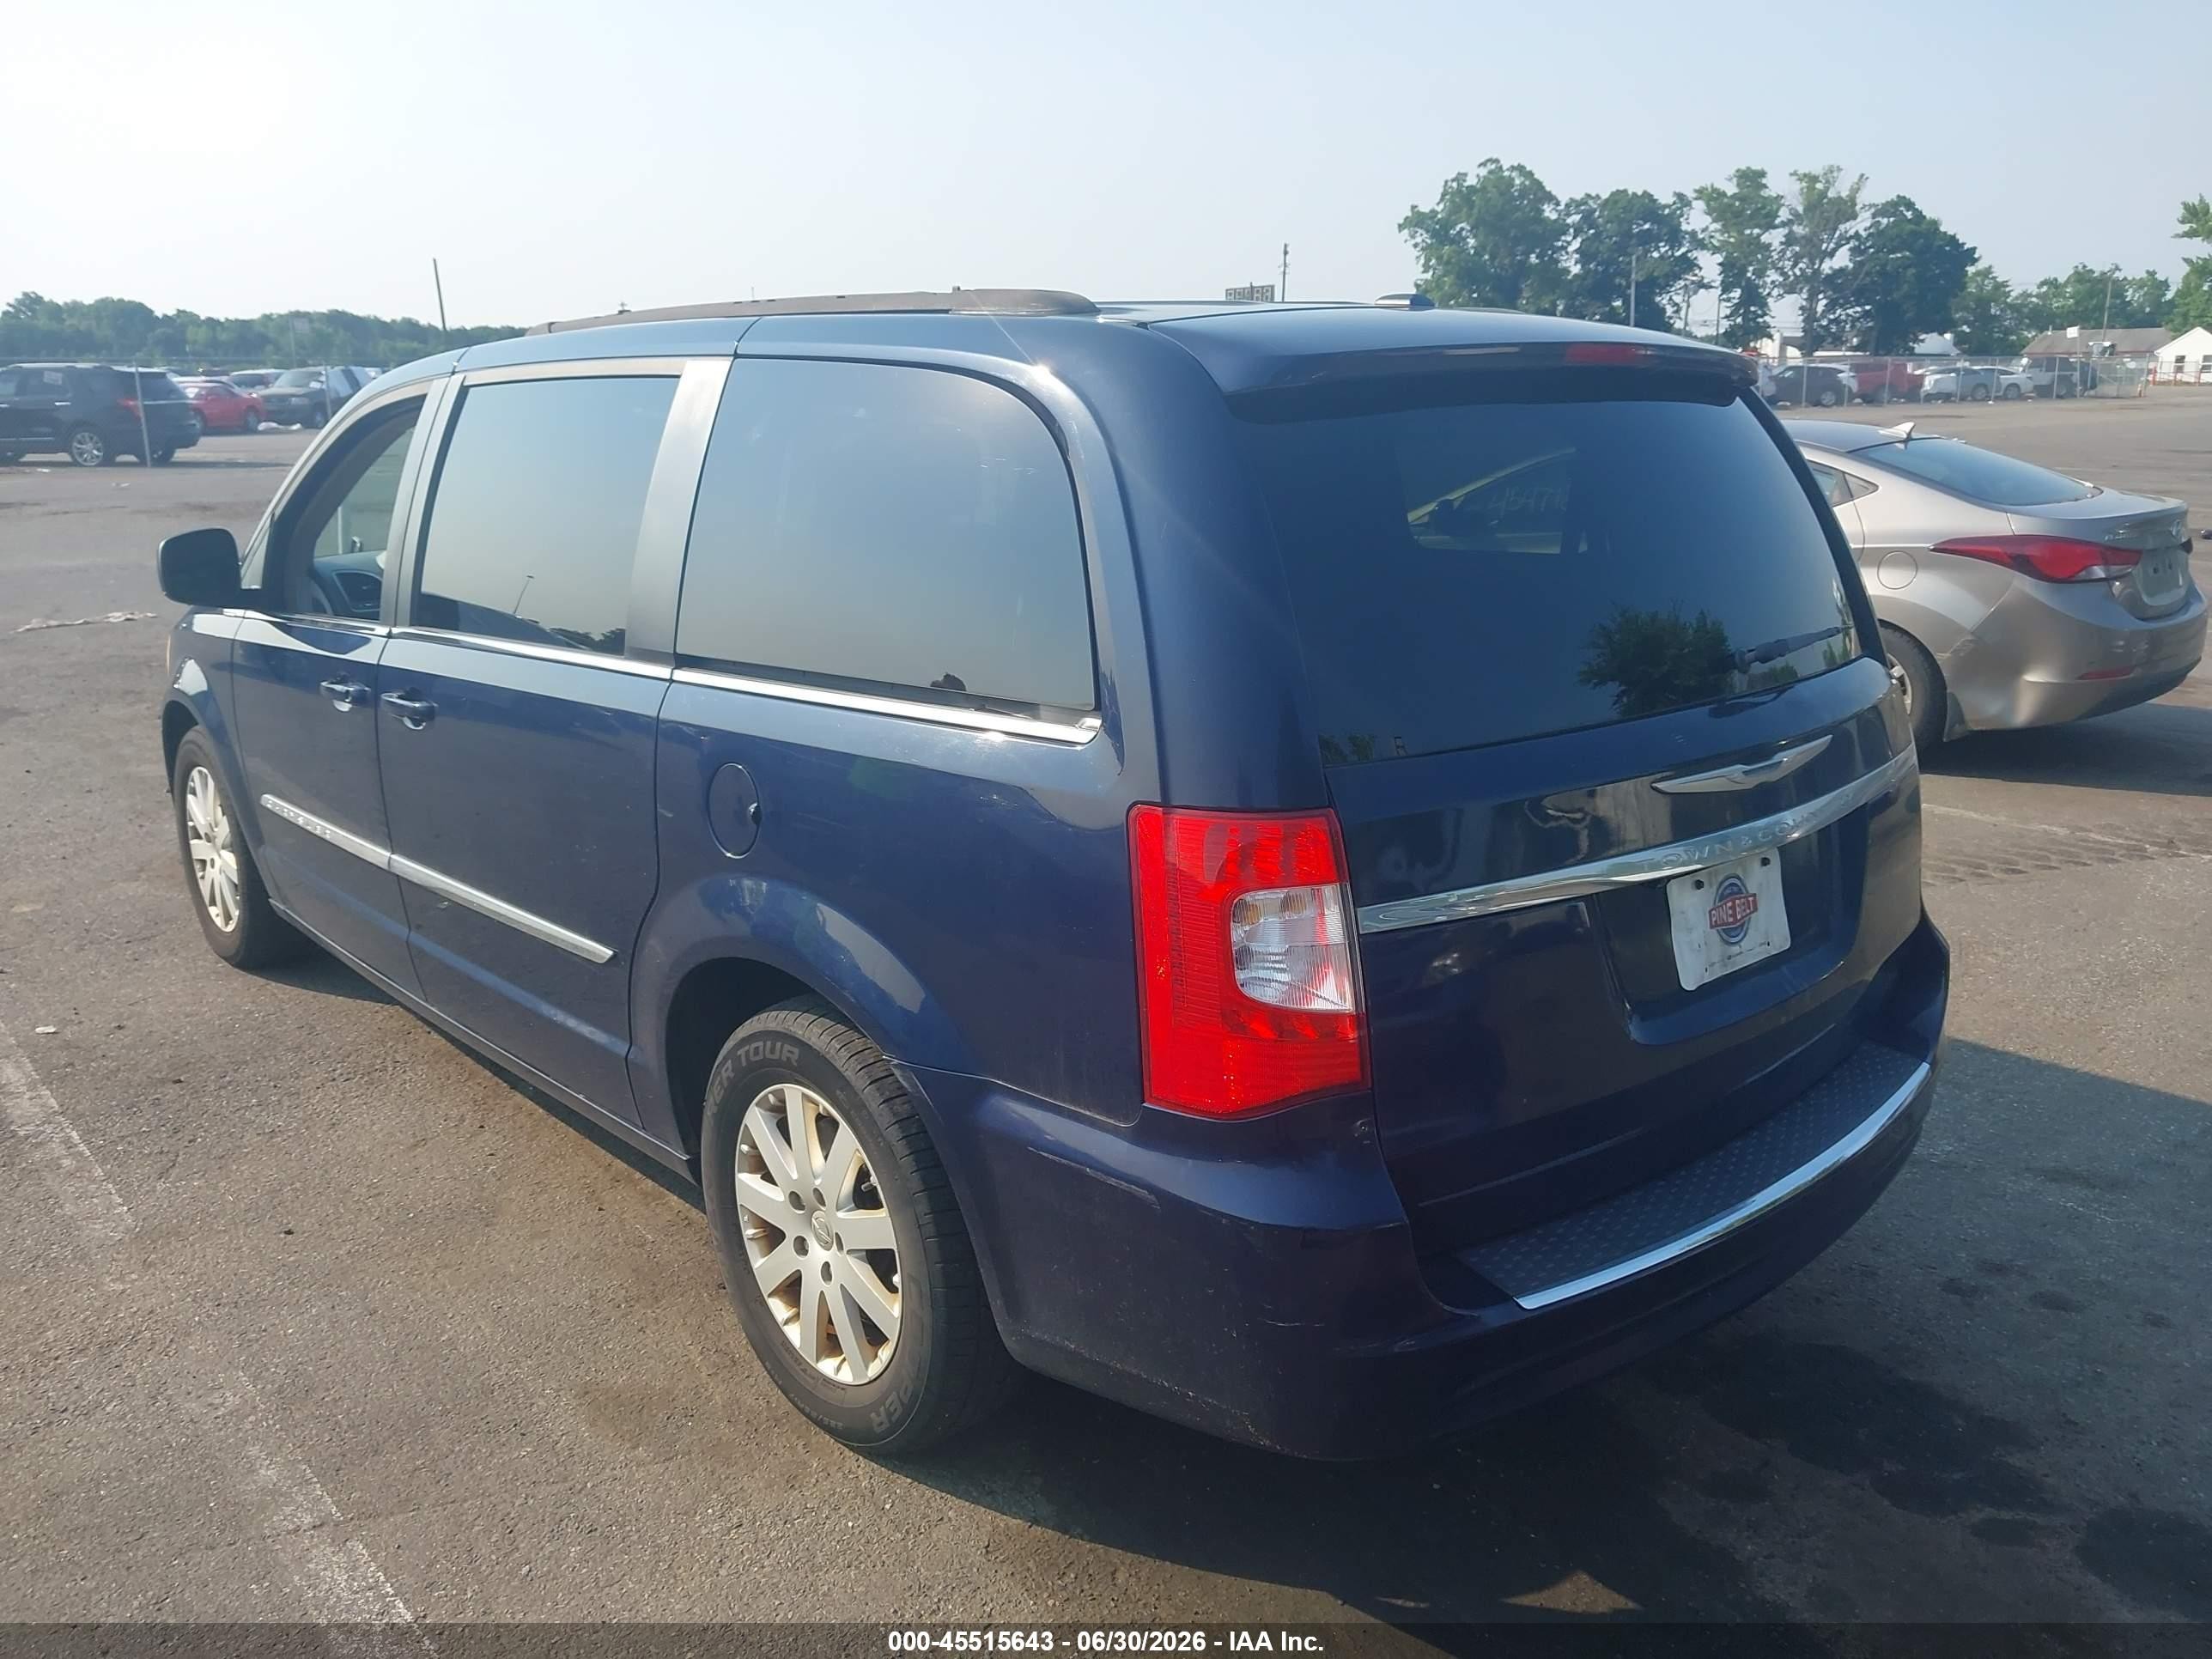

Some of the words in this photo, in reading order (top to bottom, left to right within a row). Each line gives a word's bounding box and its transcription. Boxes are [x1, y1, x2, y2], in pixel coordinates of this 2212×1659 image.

[1759, 792, 1854, 842] COUNRY
[1711, 901, 1734, 926] PINE
[1735, 896, 1754, 920] BELT
[737, 1040, 800, 1067] TOUR
